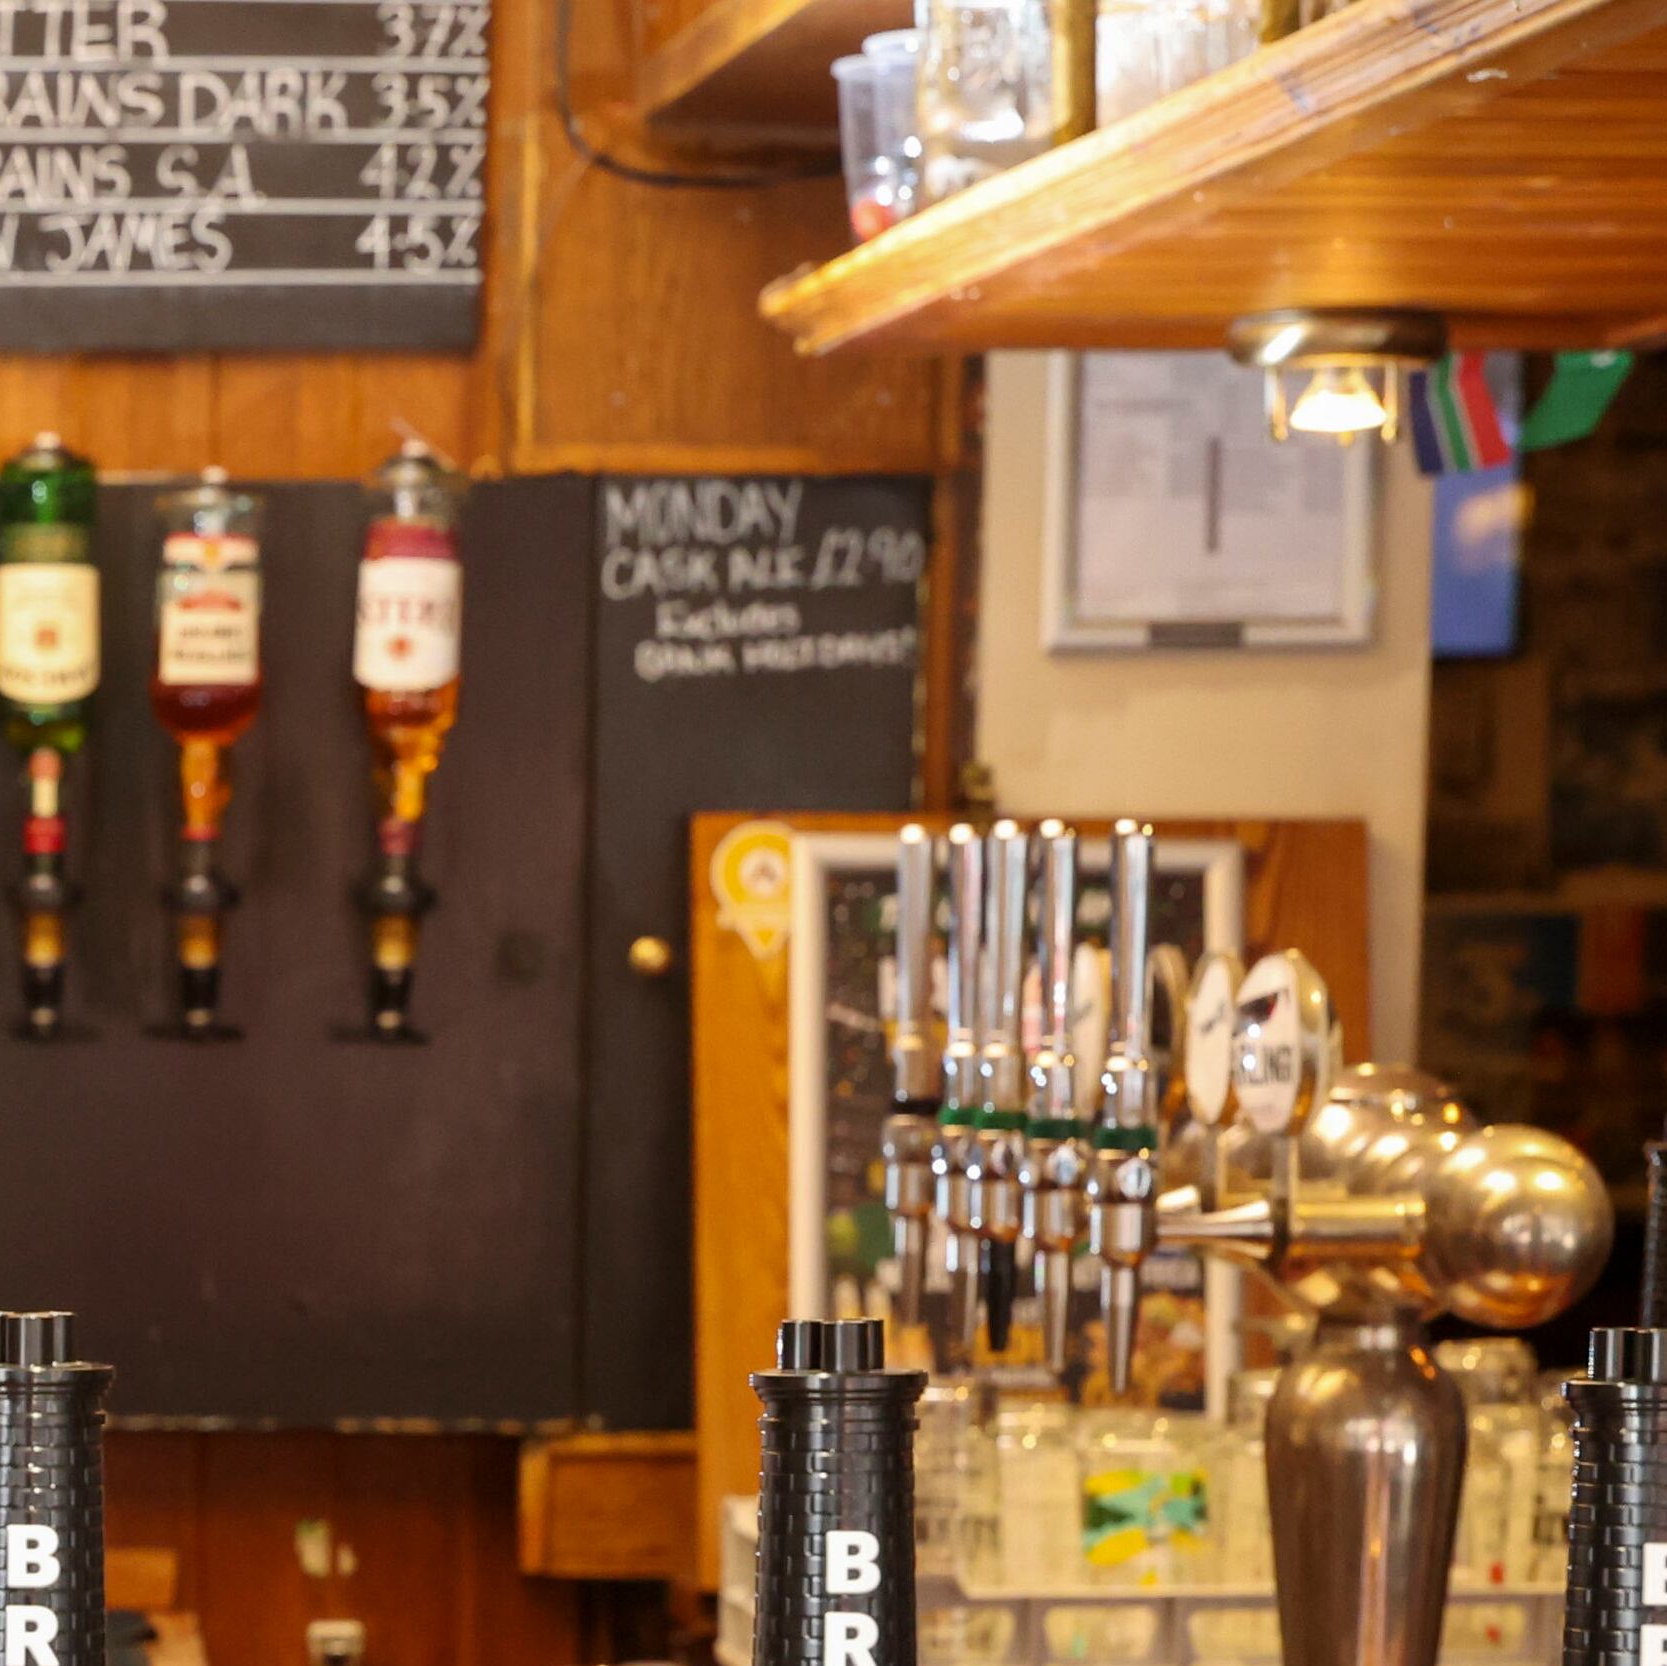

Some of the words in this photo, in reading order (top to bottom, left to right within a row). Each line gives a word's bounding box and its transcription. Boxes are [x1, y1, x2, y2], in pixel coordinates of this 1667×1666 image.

[178, 66, 349, 139] DARK
[39, 204, 233, 276] JAMES
[603, 478, 804, 548] MONDAY
[601, 546, 720, 602] CASK
